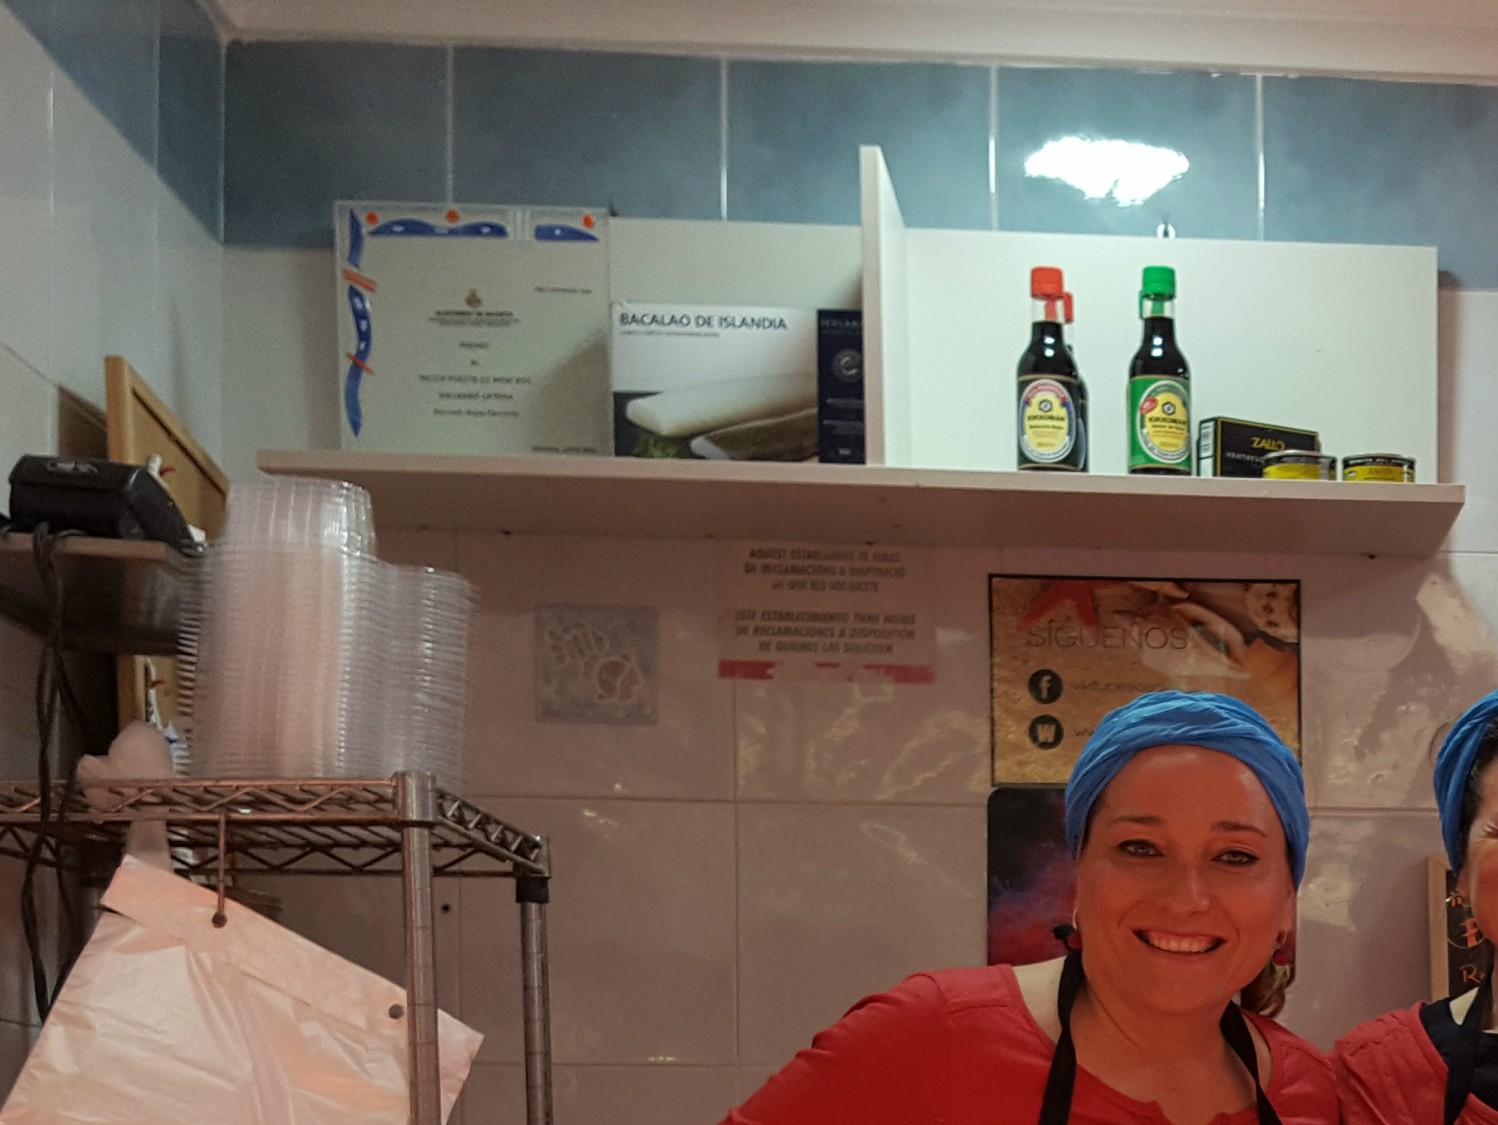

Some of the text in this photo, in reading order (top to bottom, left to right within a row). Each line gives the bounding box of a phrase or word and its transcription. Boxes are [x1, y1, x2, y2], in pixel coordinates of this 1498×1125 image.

[620, 313, 788, 330] BACALAO DE ISLANDIA
[1251, 437, 1286, 450] ZALLO
